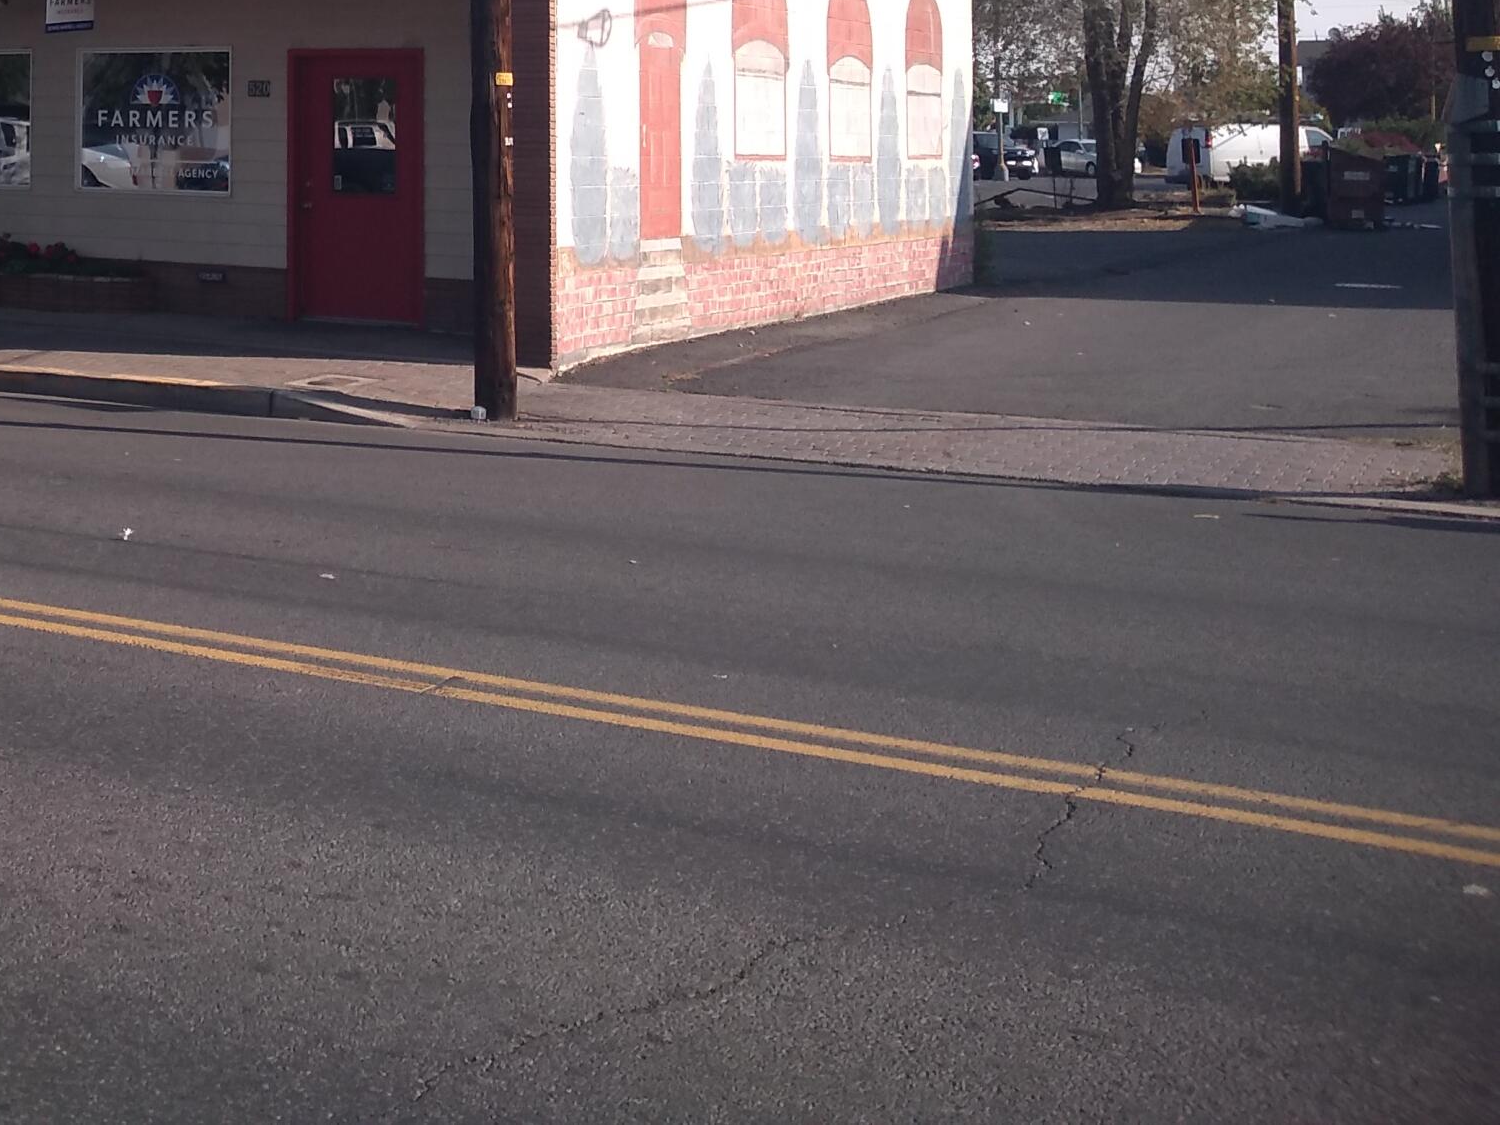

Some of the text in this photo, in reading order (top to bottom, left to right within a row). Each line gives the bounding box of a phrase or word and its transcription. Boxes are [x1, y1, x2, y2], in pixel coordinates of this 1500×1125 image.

[97, 109, 214, 128] FARMERS
[116, 134, 195, 146] INSURANCE
[178, 168, 219, 179] AGENCY
